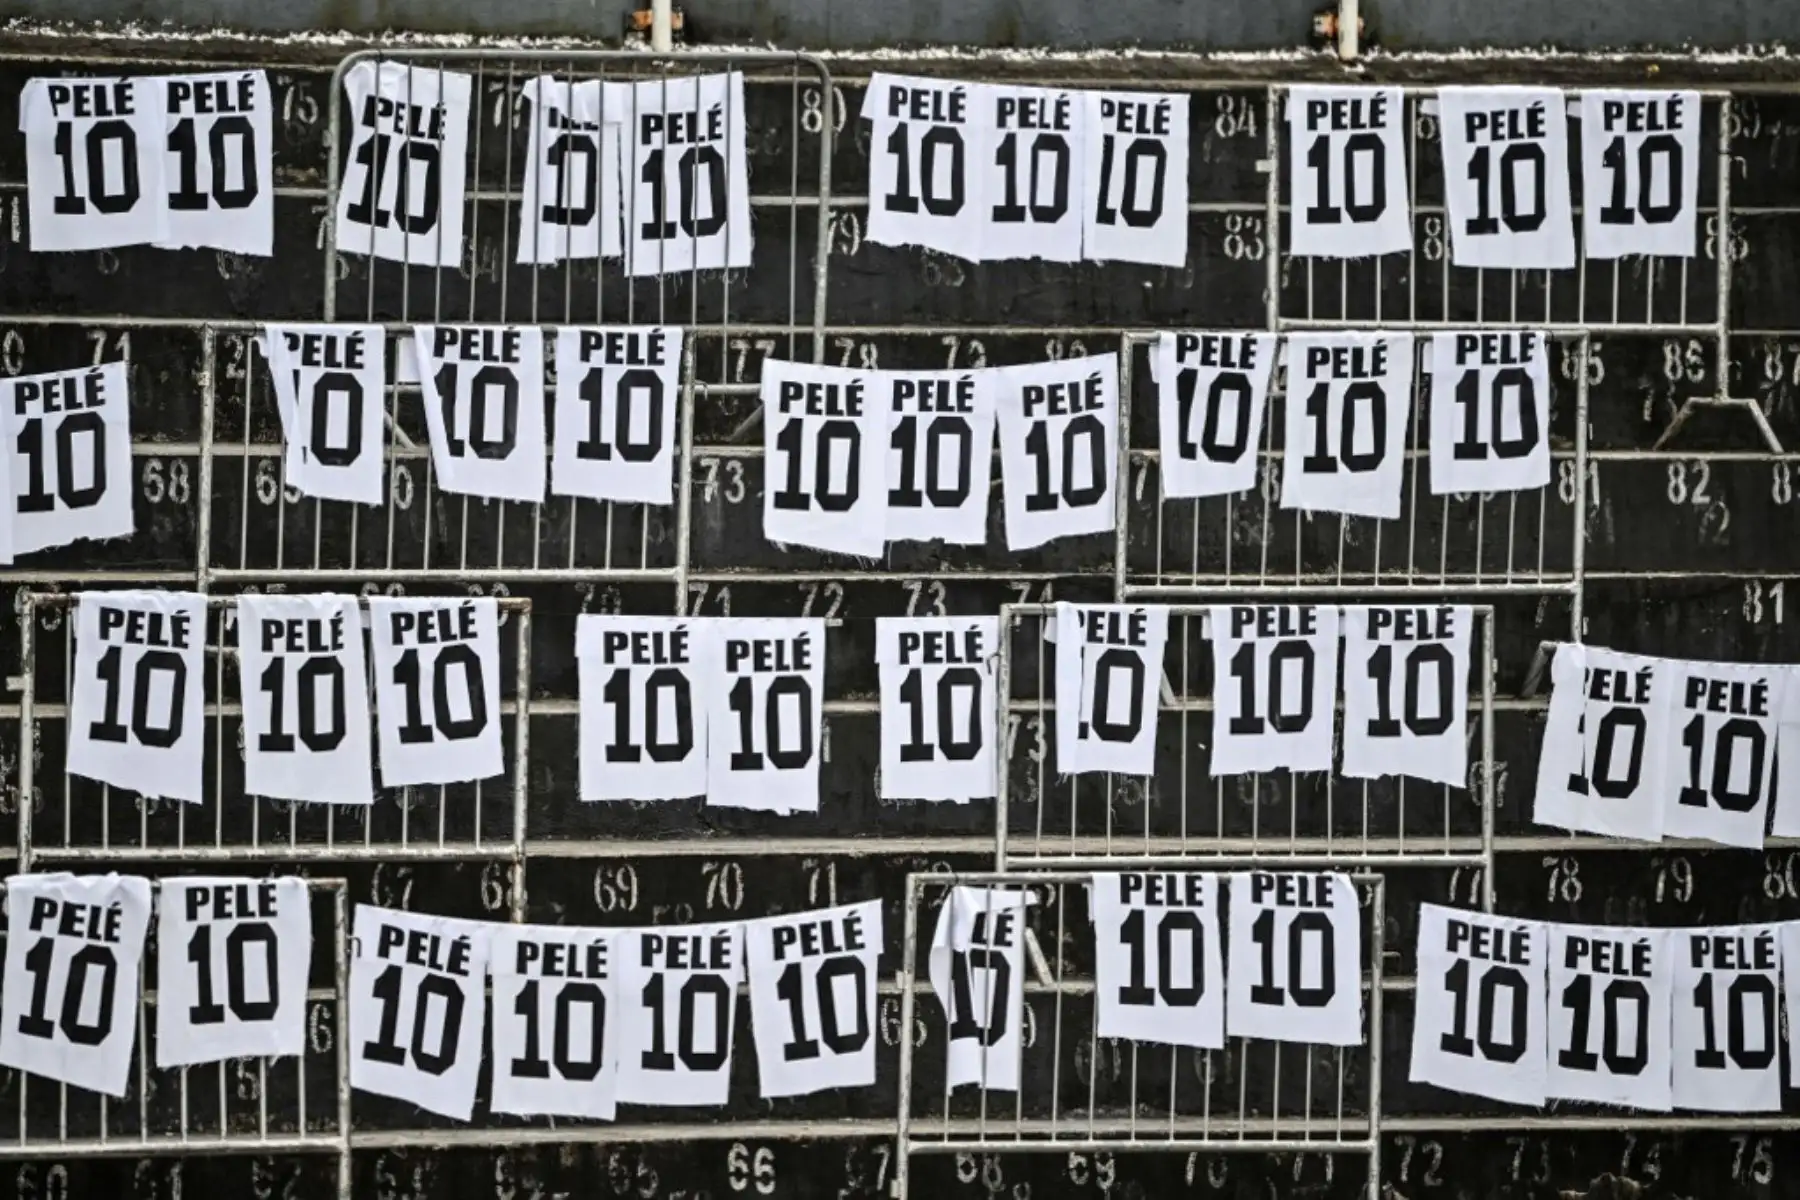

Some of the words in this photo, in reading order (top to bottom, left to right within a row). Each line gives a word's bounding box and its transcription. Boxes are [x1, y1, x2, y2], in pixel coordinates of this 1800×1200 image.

[48, 78, 135, 117] PELÉ
[167, 74, 255, 113] PELÉ
[888, 86, 966, 123] PELÉ
[997, 94, 1070, 130] PELÉ
[1215, 93, 1257, 139] 84
[1307, 92, 1387, 131] PELÉ
[1604, 94, 1684, 132] PELÉ
[641, 103, 723, 145] PELÉ
[1465, 101, 1546, 142] PELÉ
[54, 120, 140, 214] 10
[167, 116, 258, 210] 10
[346, 133, 440, 235] 10
[885, 122, 965, 216] 10
[992, 133, 1070, 223] 10
[1307, 133, 1387, 224] 10
[1601, 134, 1683, 224] 10
[641, 145, 728, 240] 10
[1466, 142, 1546, 235] 10
[1223, 213, 1264, 261] 83
[434, 326, 520, 363] PELÉ
[579, 329, 666, 365] PELÉ
[1307, 339, 1387, 379] PELÉ
[1663, 339, 1705, 384] 86
[15, 367, 106, 415] PELÉ
[434, 363, 519, 460] 10
[577, 367, 664, 462] 10
[780, 379, 864, 416] PELÉ
[893, 375, 974, 412] PELÉ
[1022, 372, 1104, 417] PELÉ
[1176, 368, 1252, 463] 10
[1454, 368, 1539, 460] 10
[293, 369, 364, 466] 0
[1303, 381, 1386, 473] 10
[17, 411, 107, 513] 10
[142, 457, 189, 504] 68
[699, 458, 745, 504] 73
[774, 418, 861, 511] 10
[888, 416, 973, 508] 10
[1025, 415, 1107, 512] 10
[1667, 460, 1712, 505] 82
[1772, 461, 1800, 506] 8
[390, 601, 478, 646] PELÉ
[688, 582, 731, 617] 71
[799, 582, 843, 627] 72
[1742, 579, 1785, 624] 81
[100, 607, 191, 649] PELÉ
[262, 611, 344, 652] PELÉ
[603, 625, 690, 665] PELÉ
[899, 626, 984, 665] PELÉ
[1078, 609, 1148, 646] ELÉ
[726, 632, 812, 673] PELÉ
[89, 646, 187, 748] 10
[259, 656, 346, 752] 10
[393, 643, 488, 744] 10
[1078, 649, 1146, 743] 0
[1230, 640, 1315, 735] 10
[1368, 643, 1455, 738] 10
[1584, 666, 1654, 704] ELÉ
[1684, 678, 1769, 717] PELÉ
[604, 667, 694, 763] 10
[729, 676, 812, 771] 10
[899, 668, 983, 762] 10
[1678, 714, 1767, 813] 10
[593, 863, 637, 912] 69
[701, 861, 744, 911] 70
[802, 860, 837, 907] 71
[1542, 856, 1582, 903] 78
[1651, 857, 1693, 904] 79
[29, 897, 123, 943] PELÉ
[773, 912, 866, 961] PELÉ
[971, 909, 1014, 947] LÉ
[1446, 919, 1531, 966] PELÉ
[188, 922, 279, 1024] 10
[377, 924, 471, 977] PELÉ
[516, 939, 608, 979] PELÉ
[641, 930, 732, 969] PELÉ
[1119, 909, 1204, 1007] 10
[1250, 908, 1335, 1007] 10
[1564, 935, 1652, 978] PELÉ
[1690, 931, 1776, 970] PELÉ
[18, 937, 118, 1047] 10
[777, 955, 870, 1062] 10
[1440, 958, 1529, 1064] 10
[363, 964, 465, 1076] 10
[511, 980, 606, 1081] 10
[641, 973, 731, 1071] 10
[1558, 974, 1650, 1076] 10
[1694, 973, 1776, 1070] 10
[727, 1142, 776, 1195] 66
[1394, 1134, 1444, 1187] 72
